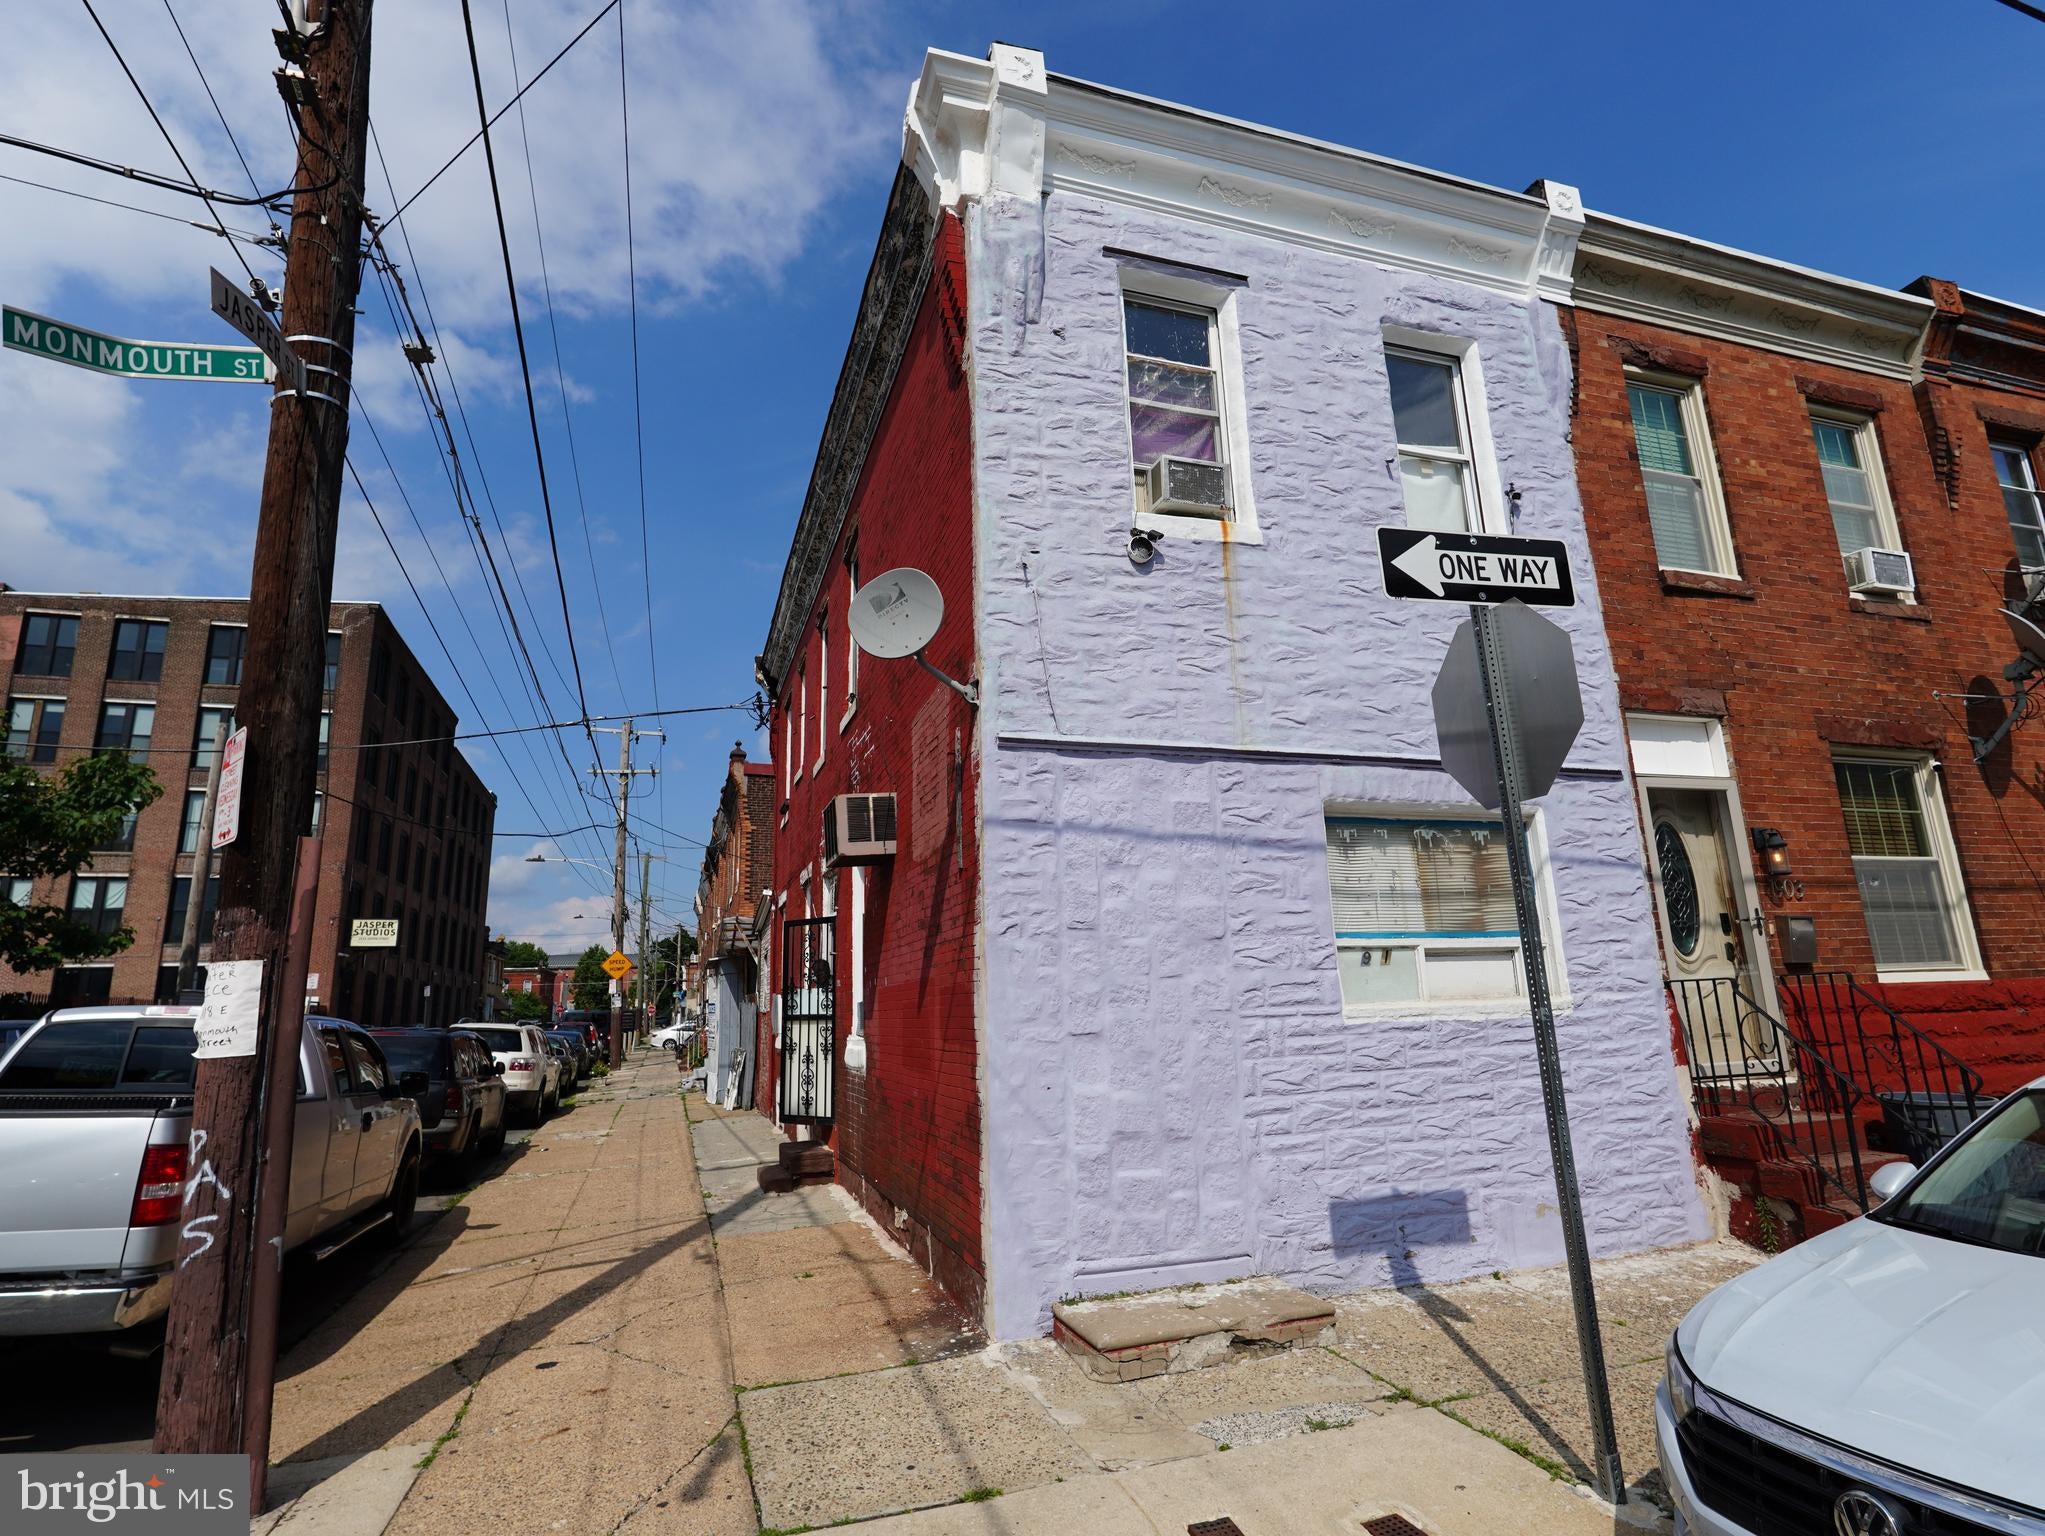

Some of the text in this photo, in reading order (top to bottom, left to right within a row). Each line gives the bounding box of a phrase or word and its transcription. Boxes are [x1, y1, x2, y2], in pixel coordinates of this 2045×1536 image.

[13, 315, 260, 377] MONMOUTH ST
[219, 287, 295, 378] JASPER ST
[1438, 553, 1549, 585] ONE WAY
[352, 928, 396, 936] STUDIOS
[356, 921, 394, 929] JASPER
